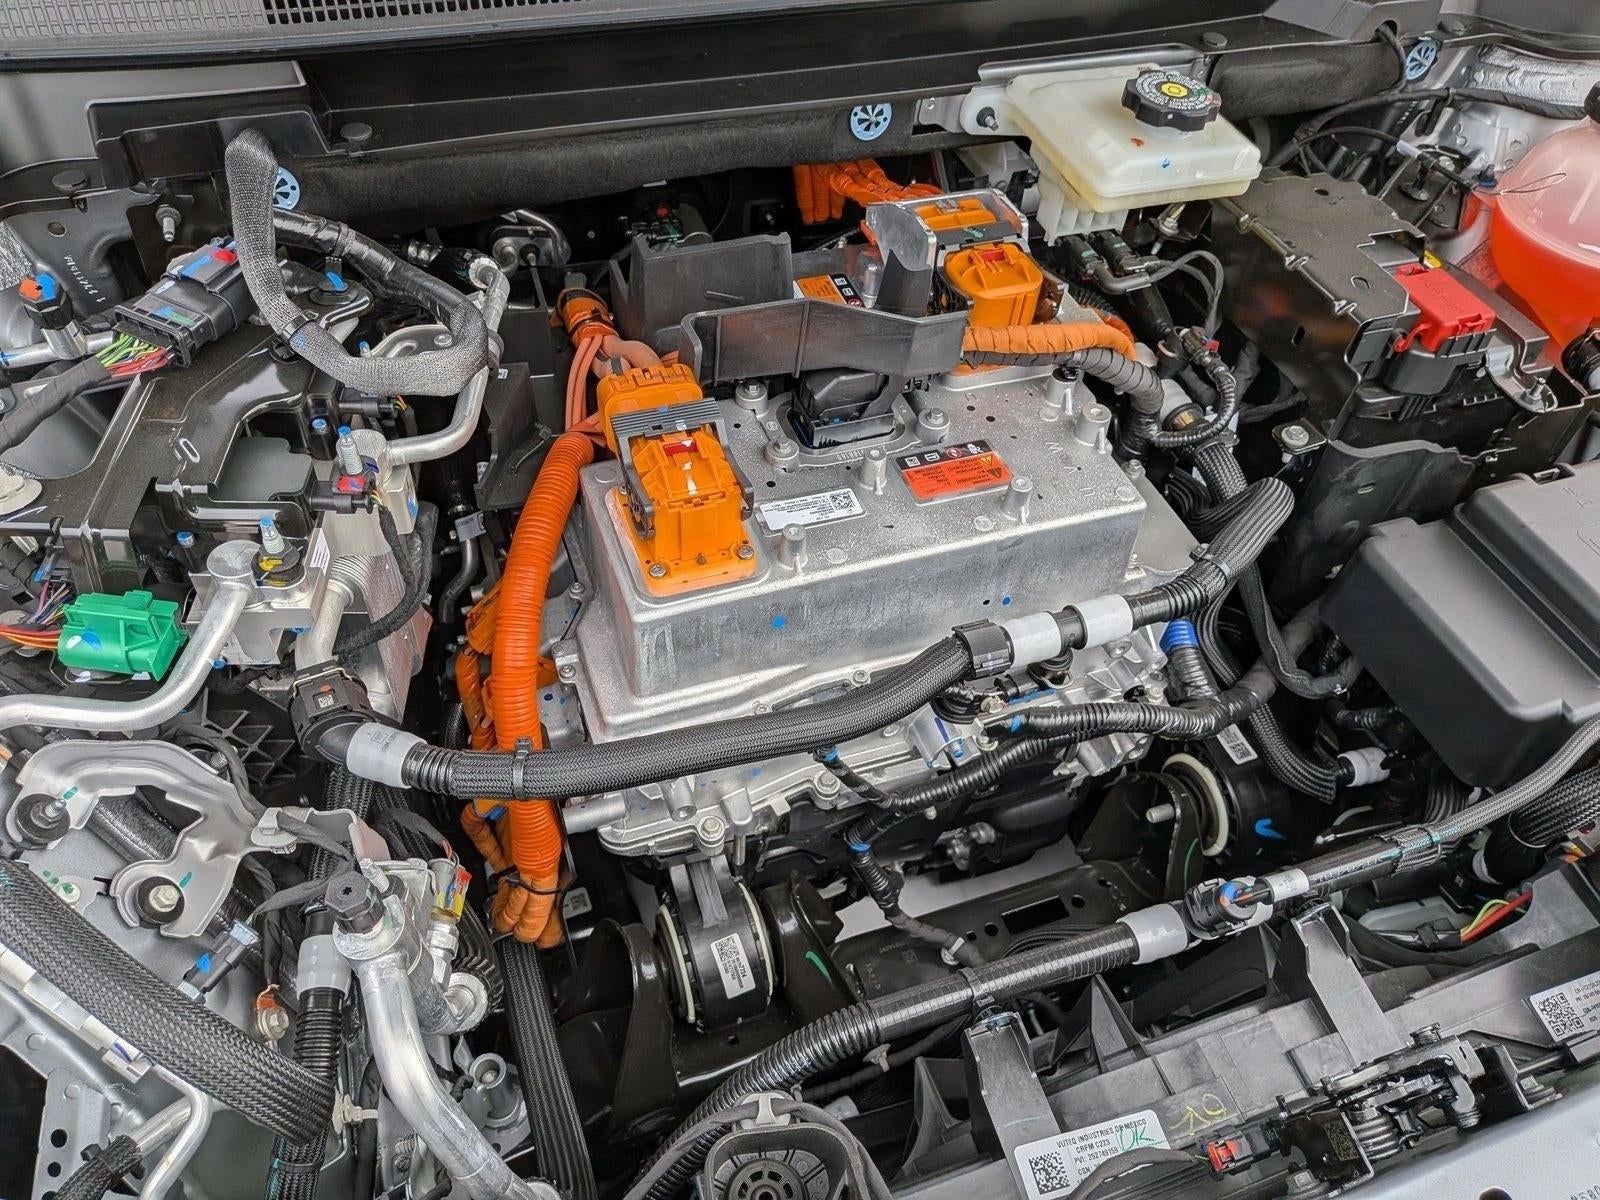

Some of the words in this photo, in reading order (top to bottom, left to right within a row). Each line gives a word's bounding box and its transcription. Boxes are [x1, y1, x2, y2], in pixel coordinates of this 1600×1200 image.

[1056, 1136, 1077, 1149] VUTEQ
[1077, 1128, 1114, 1145] INDUSTRIES
[1114, 1124, 1124, 1133] OF
[1124, 1118, 1147, 1131] MEXICO
[1075, 1143, 1095, 1154] CRFM
[1095, 1138, 1111, 1149] C223
